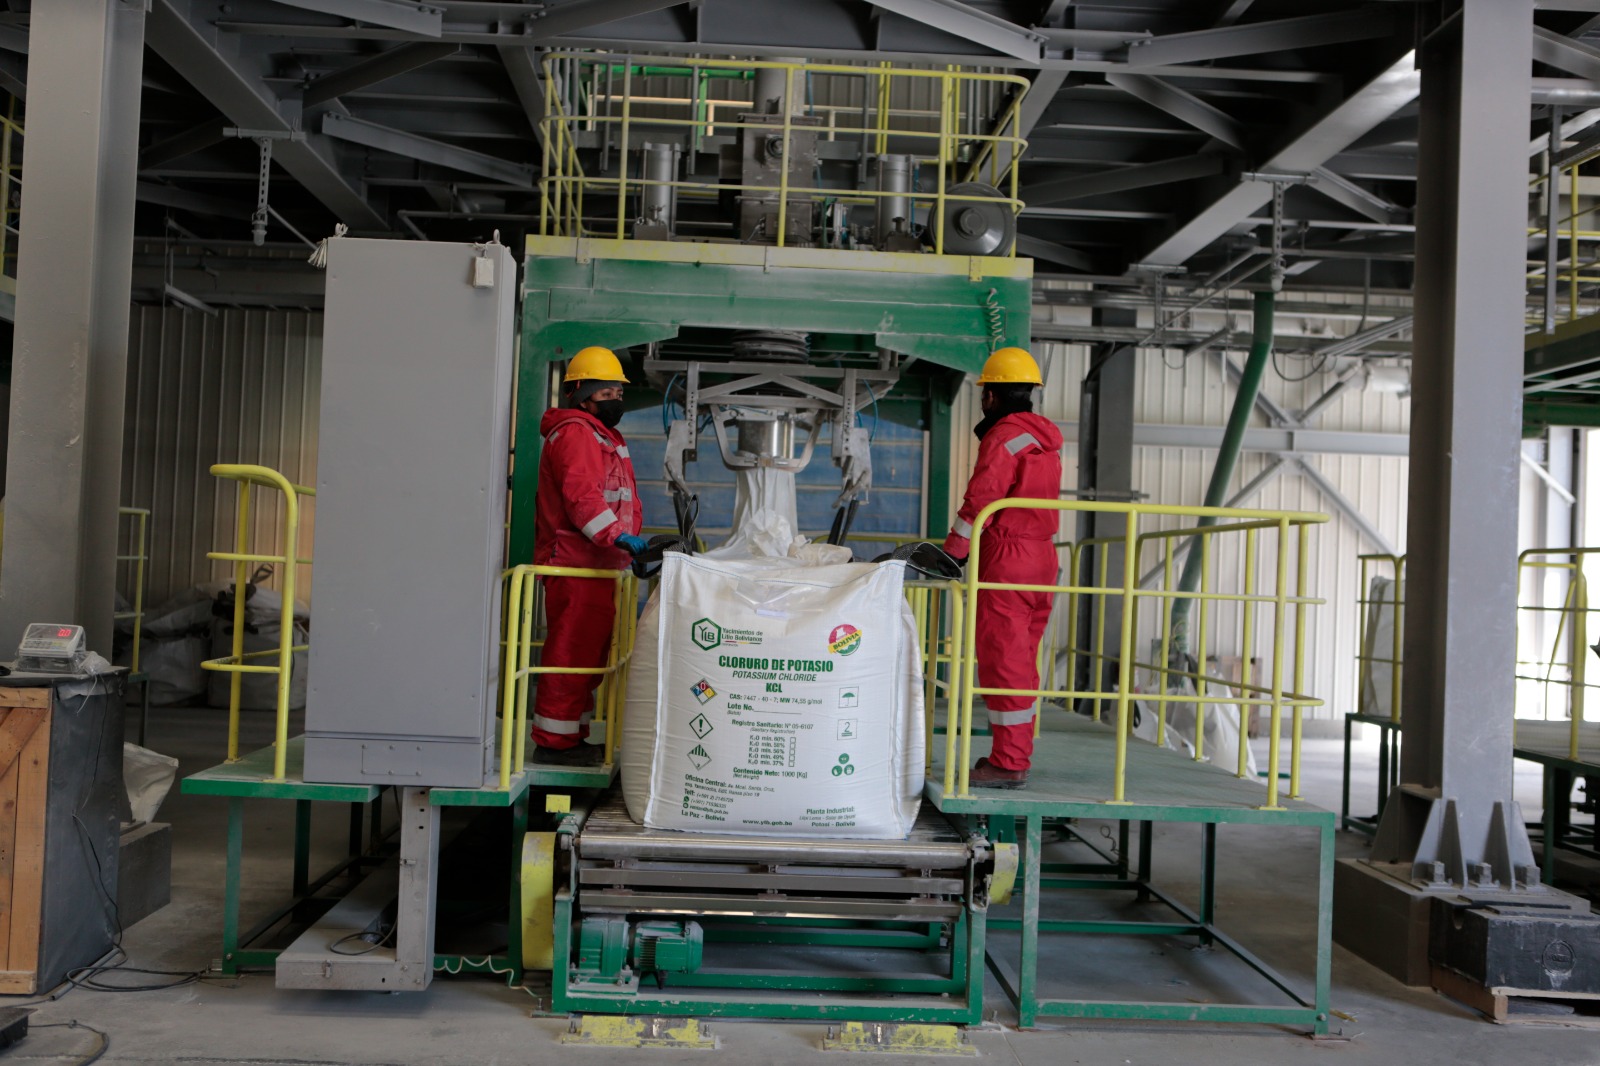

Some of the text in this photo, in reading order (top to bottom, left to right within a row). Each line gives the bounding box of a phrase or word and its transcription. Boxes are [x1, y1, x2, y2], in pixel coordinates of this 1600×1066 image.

[698, 626, 714, 642] YLB
[722, 628, 754, 636] Yacimientos
[833, 633, 859, 649] BOLIVIA
[718, 655, 833, 672] CLORURO DE POTASIO
[732, 670, 817, 681] POTASSIUM CHLORIDE
[844, 722, 850, 732] 2
[733, 767, 763, 775] Contenido
[685, 774, 704, 783] Oficina
[705, 778, 726, 787] Central:
